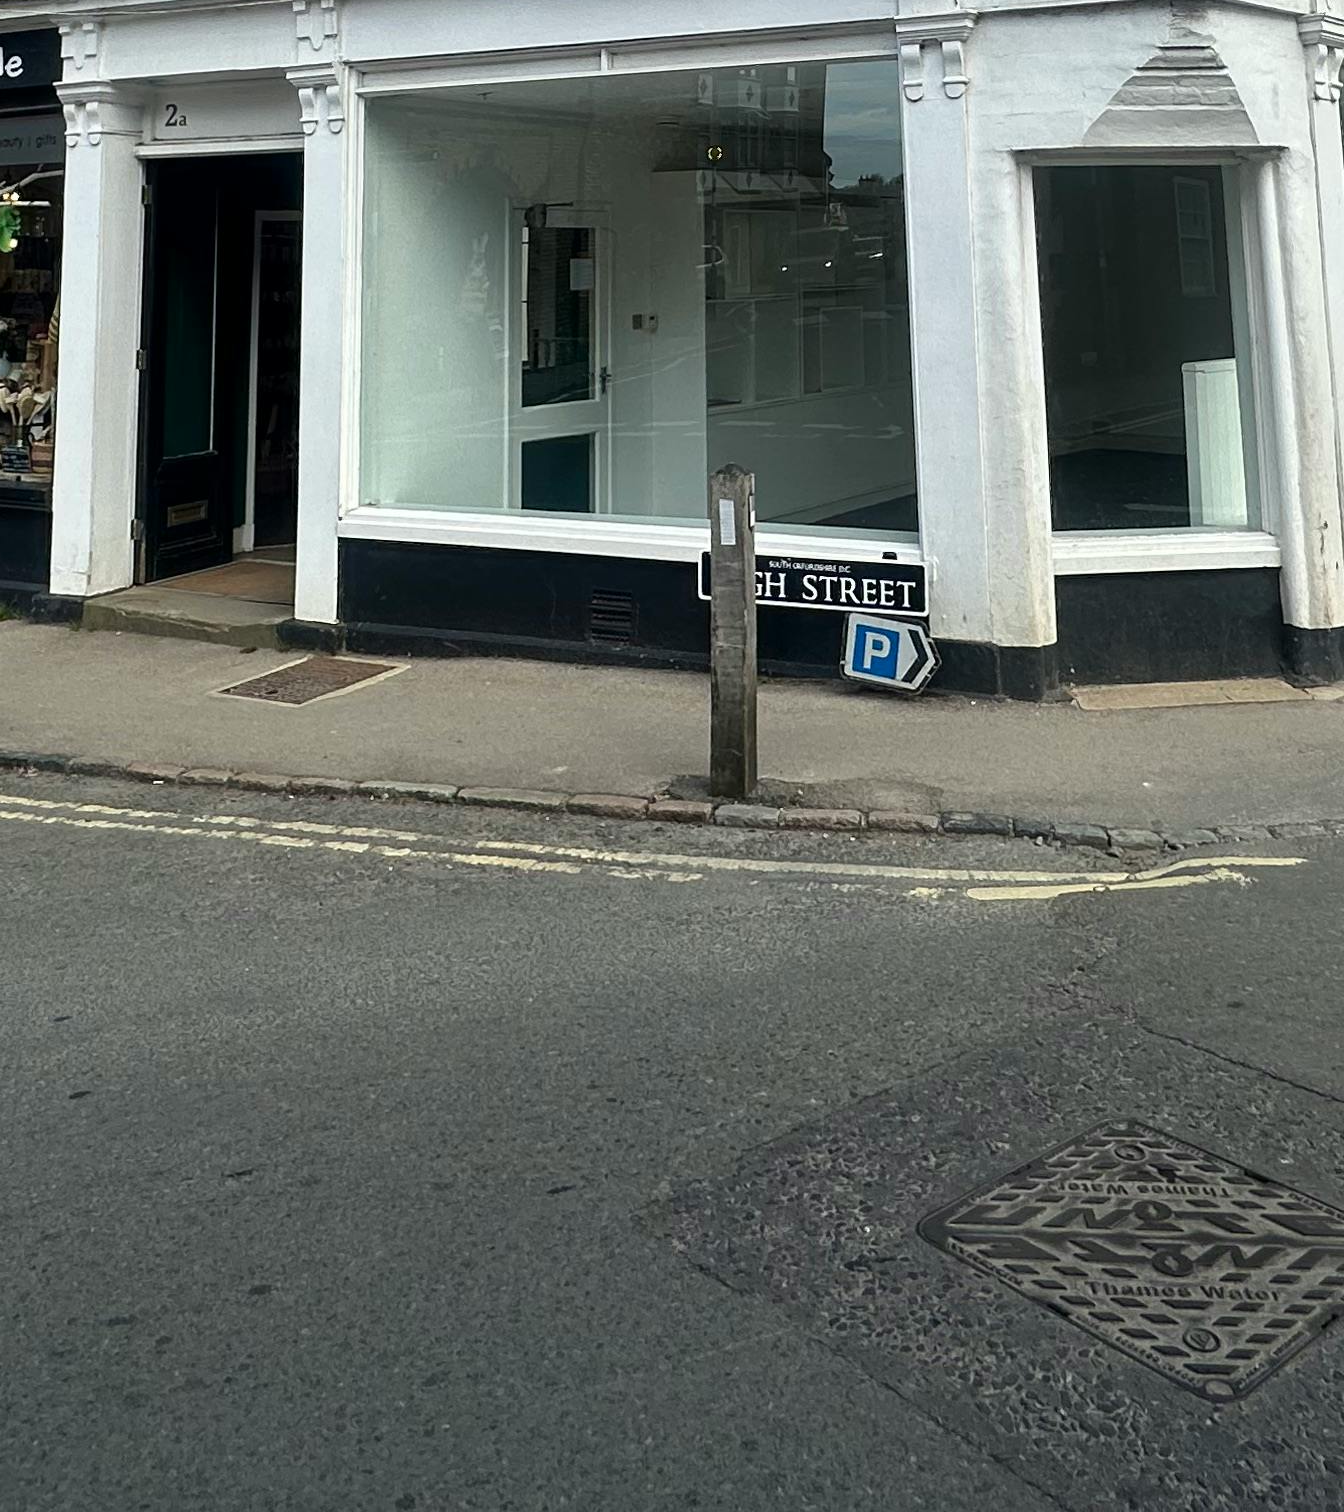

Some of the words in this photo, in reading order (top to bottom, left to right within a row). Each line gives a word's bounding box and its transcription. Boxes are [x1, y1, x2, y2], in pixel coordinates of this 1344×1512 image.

[165, 103, 187, 127] 2a
[754, 571, 787, 598] GH
[802, 574, 916, 608] STREET
[863, 631, 891, 670] P
[1085, 1281, 1192, 1298] Thames
[1199, 1285, 1280, 1302] Water
